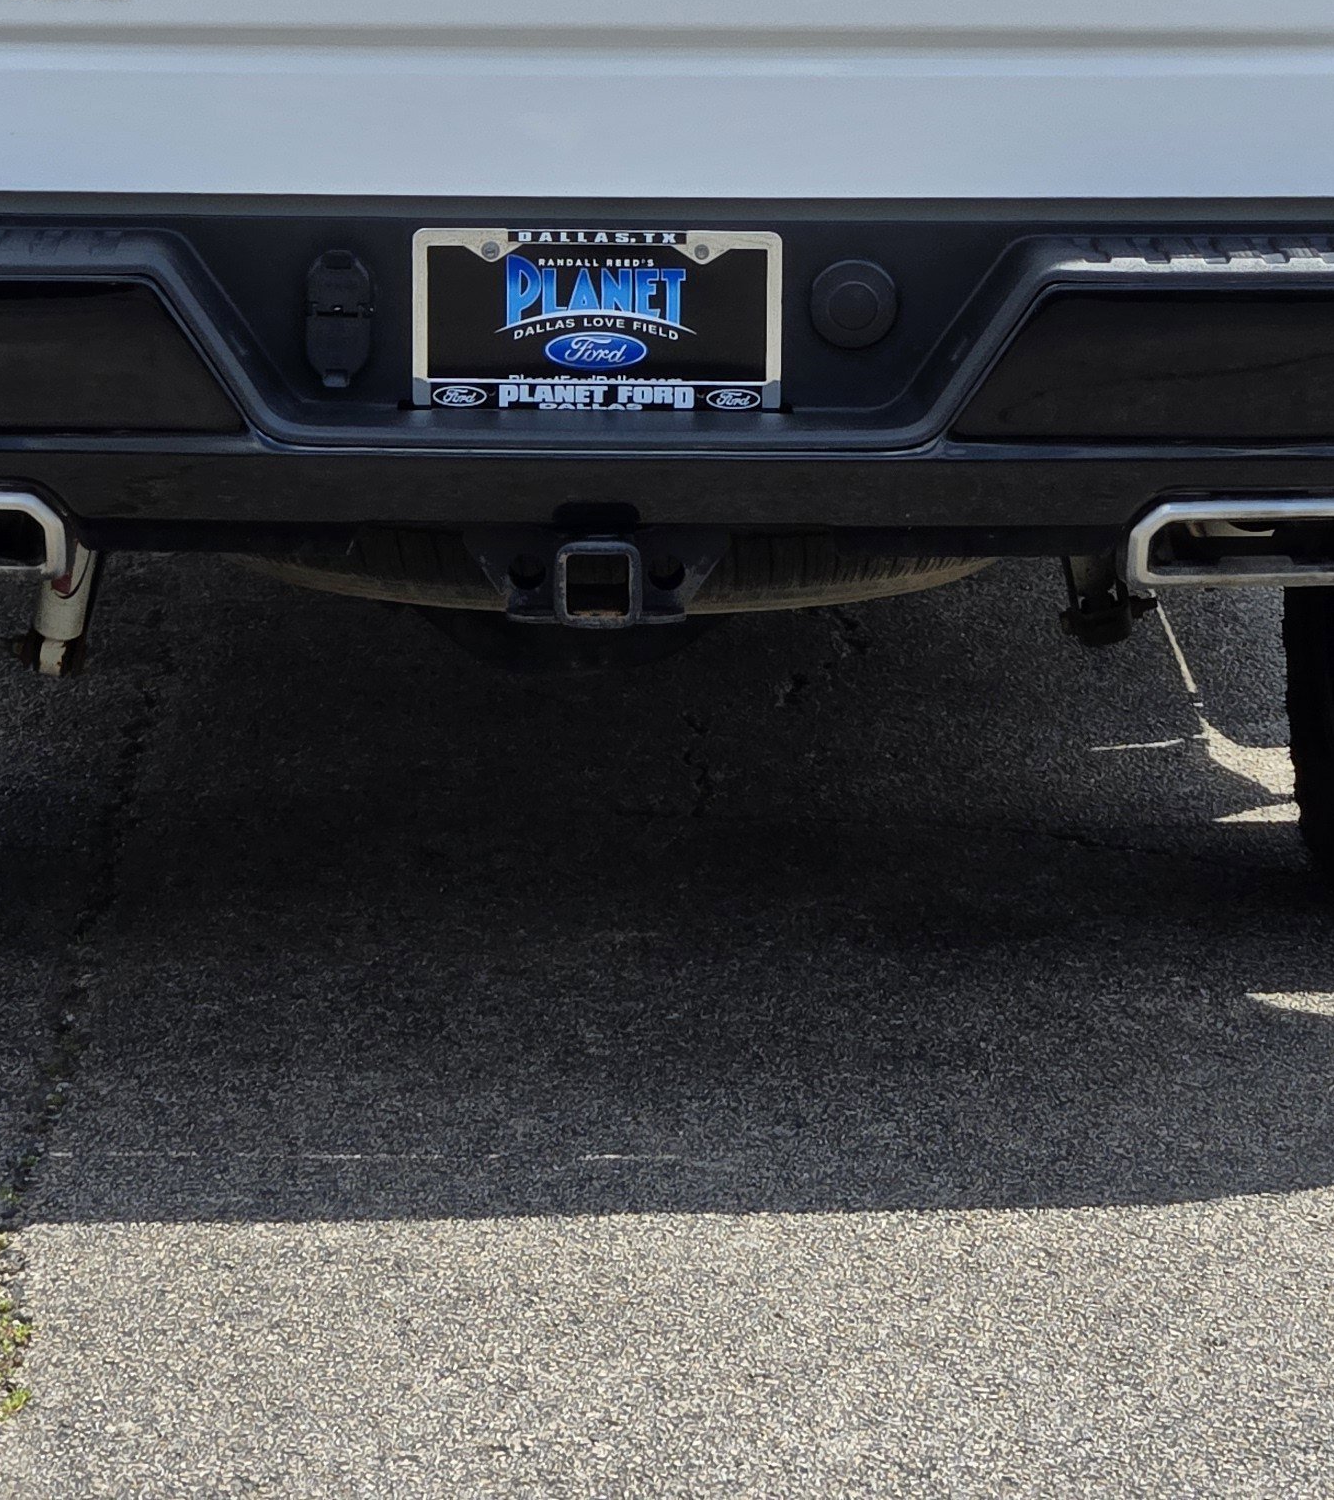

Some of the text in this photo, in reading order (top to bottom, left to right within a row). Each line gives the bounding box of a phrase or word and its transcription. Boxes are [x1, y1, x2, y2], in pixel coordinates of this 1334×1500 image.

[538, 258, 655, 267] RANDALL REED'S
[506, 254, 686, 328] PLANET
[514, 317, 679, 341] DALLAS LOVE FIELD
[499, 384, 694, 409] PLANET FORD
[539, 402, 643, 411] DALLAS
